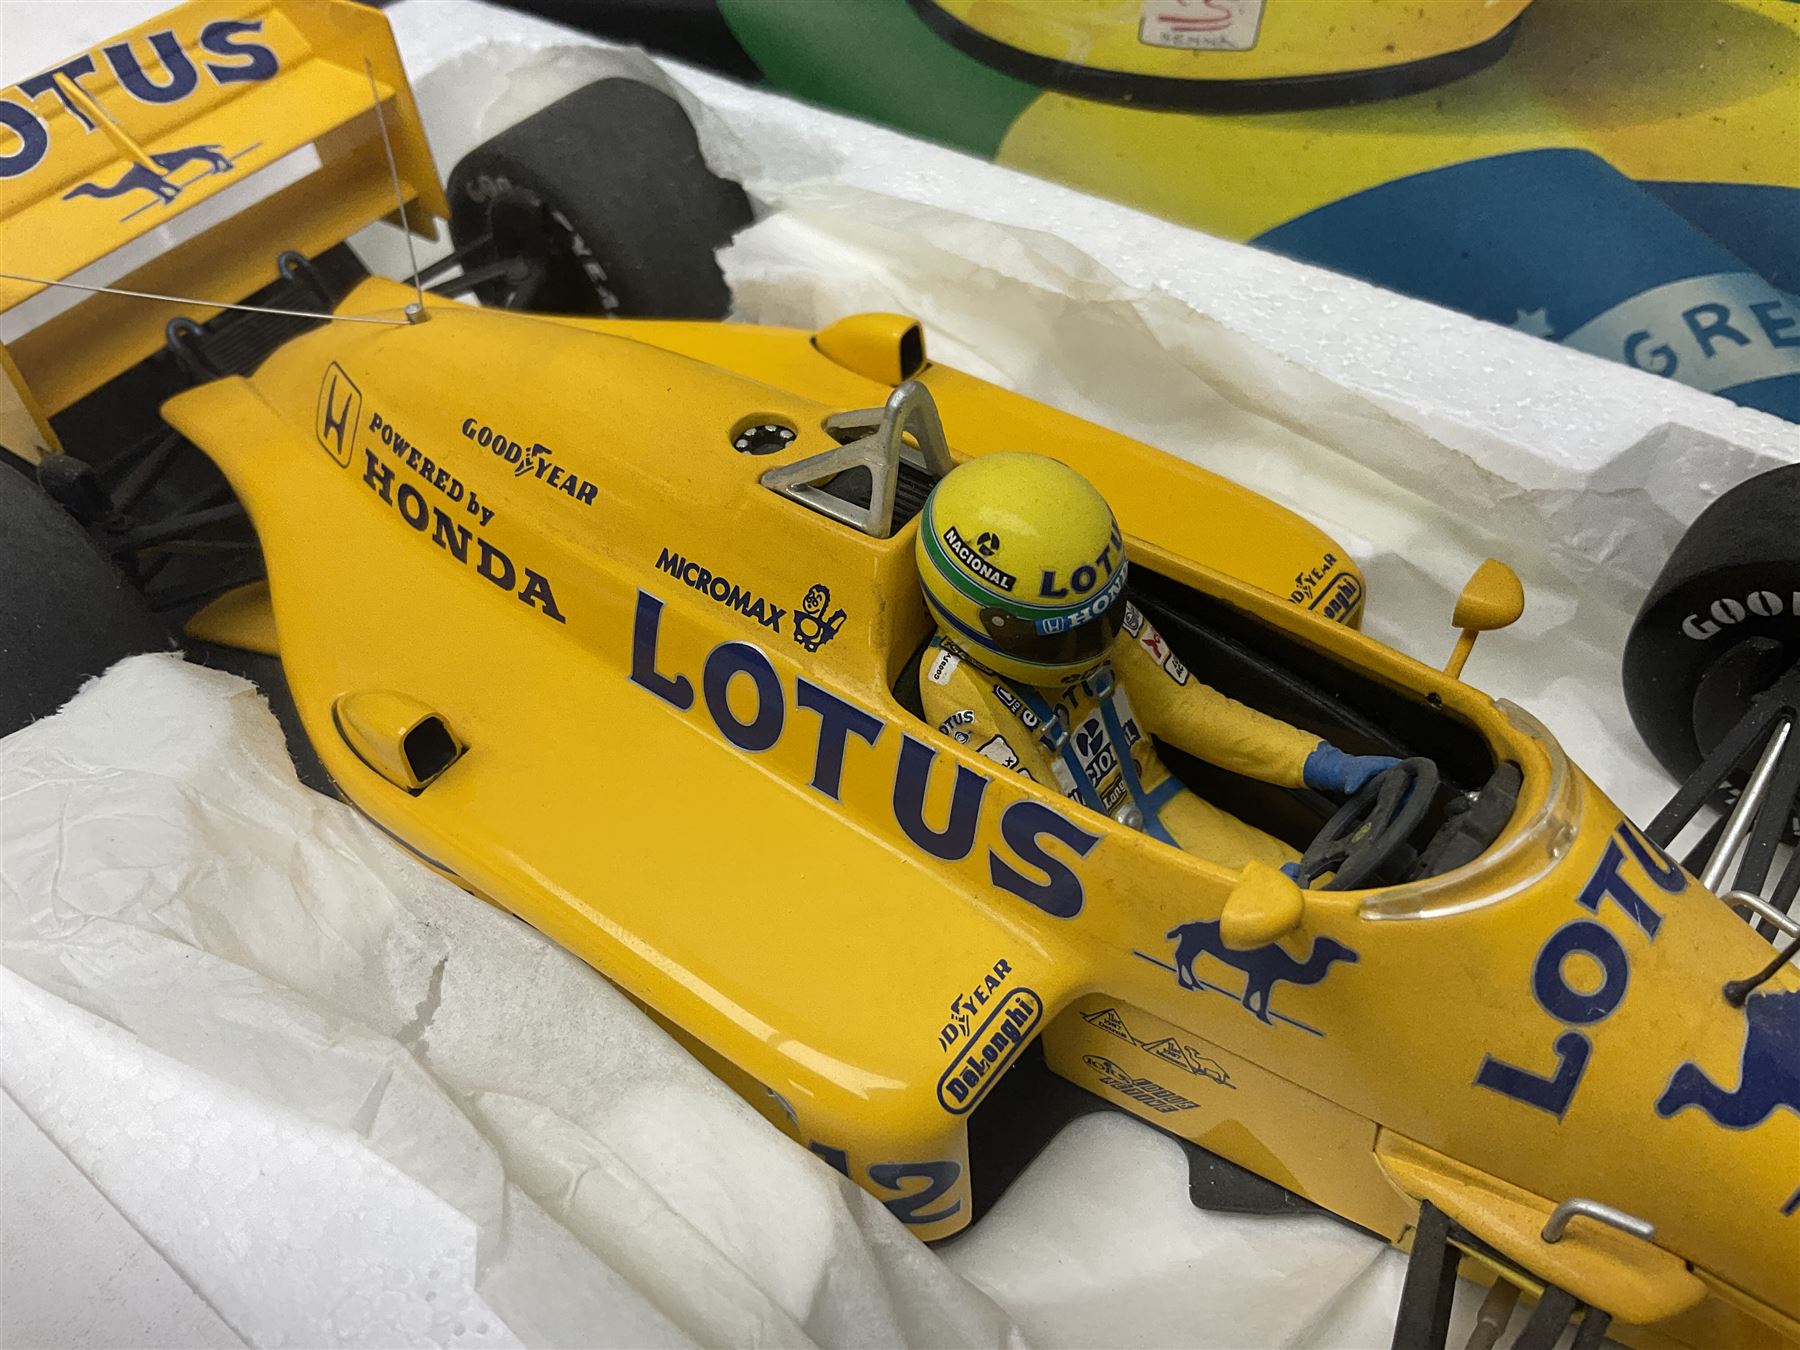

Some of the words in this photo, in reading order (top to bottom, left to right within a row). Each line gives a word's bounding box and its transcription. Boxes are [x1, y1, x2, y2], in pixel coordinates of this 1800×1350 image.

[369, 412, 464, 502] POWERED
[470, 491, 495, 527] by
[462, 418, 599, 506] GOODYEAR
[362, 448, 566, 625] HONDA
[945, 529, 1010, 591] NACIONAL
[1288, 553, 1338, 605] DYEAR
[655, 547, 787, 634] MICROMAX
[626, 587, 1106, 920] LOTUS
